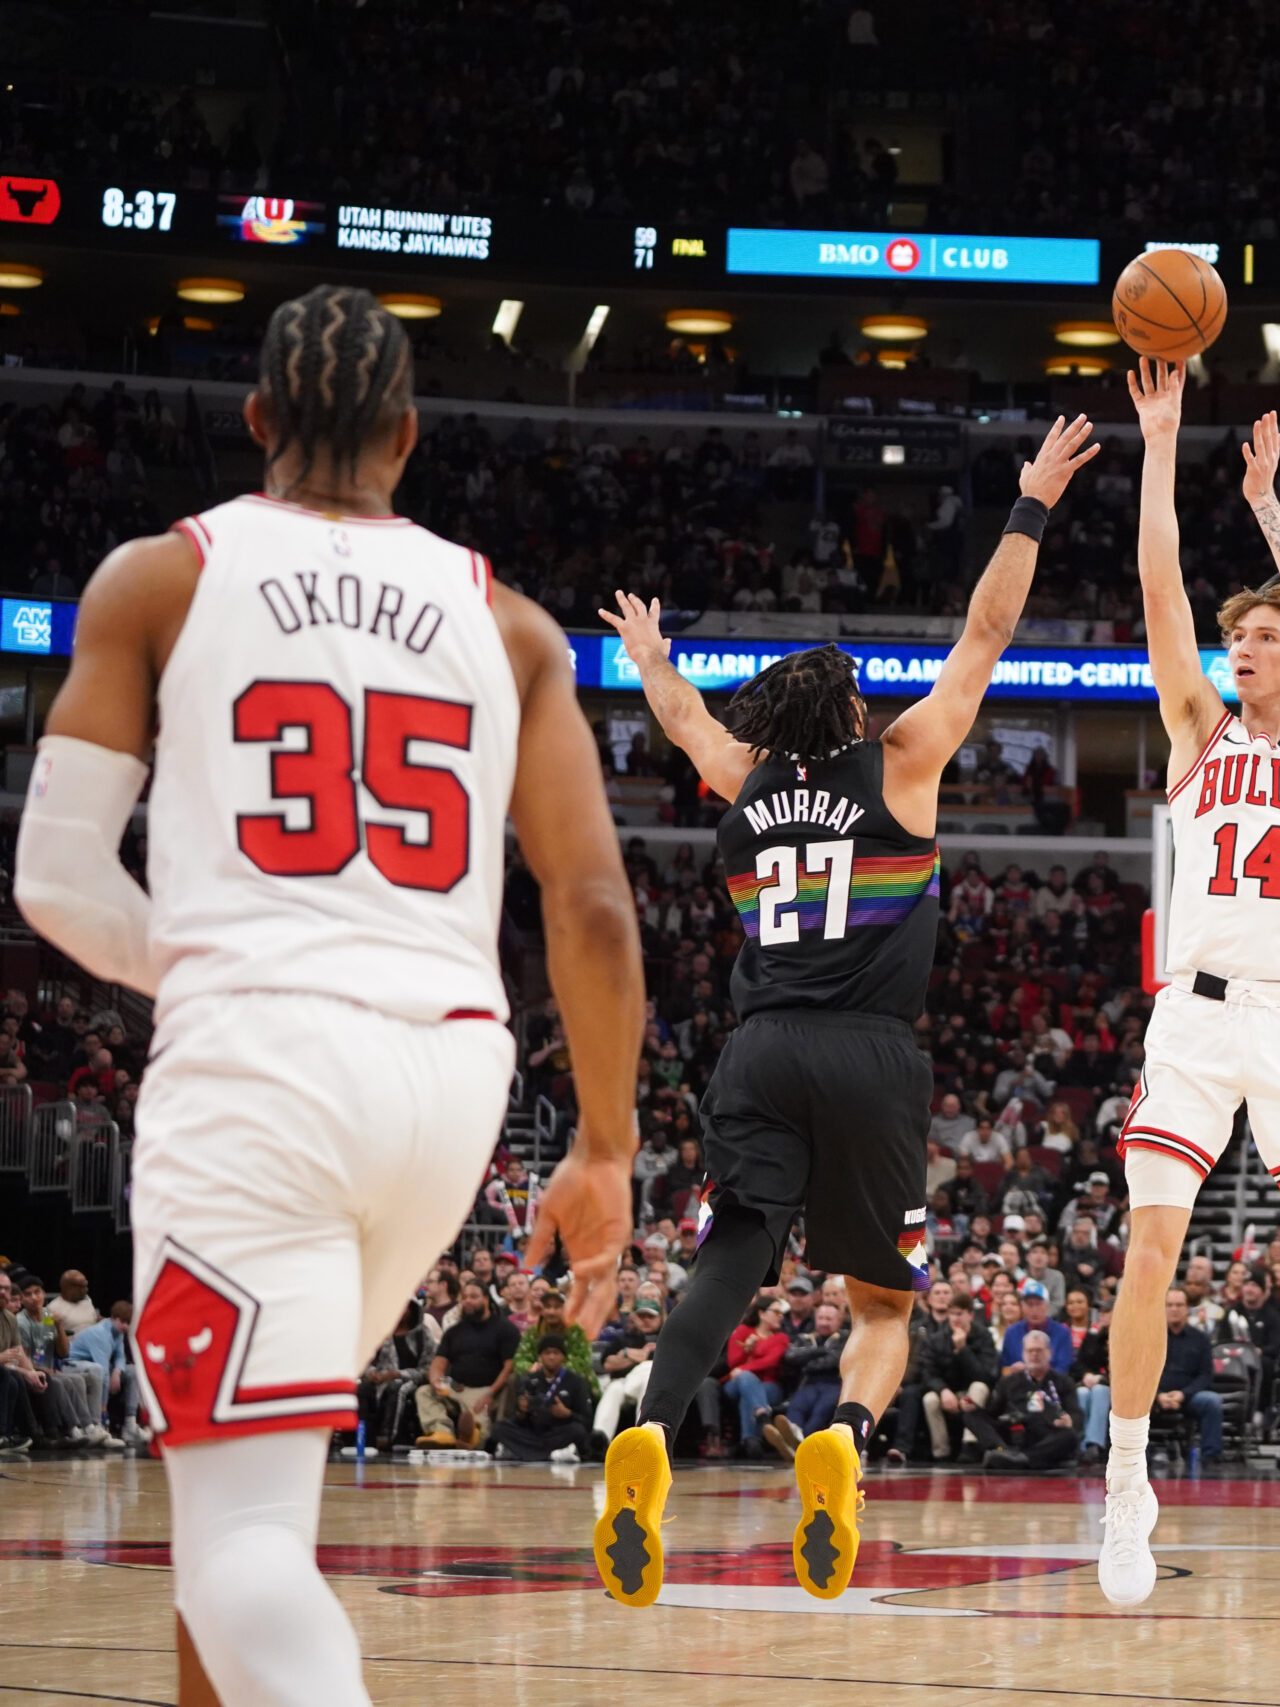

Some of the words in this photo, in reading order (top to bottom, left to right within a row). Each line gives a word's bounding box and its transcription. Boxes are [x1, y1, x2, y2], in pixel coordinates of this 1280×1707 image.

[102, 187, 176, 231] 8:37
[338, 206, 381, 228] UTAH
[383, 209, 449, 233] RUNNIN'
[450, 215, 492, 238] UTES
[337, 227, 401, 252] KANSAS
[402, 233, 490, 259] JAYHAWKS
[635, 227, 657, 248] 59
[634, 248, 654, 269] 71
[819, 243, 879, 265] BMO
[943, 247, 1009, 269] CLUB
[259, 571, 444, 655] OKORO
[677, 652, 756, 678] LEARN
[233, 680, 473, 893] 35
[743, 789, 866, 836] MURRAY
[755, 838, 855, 947] 27
